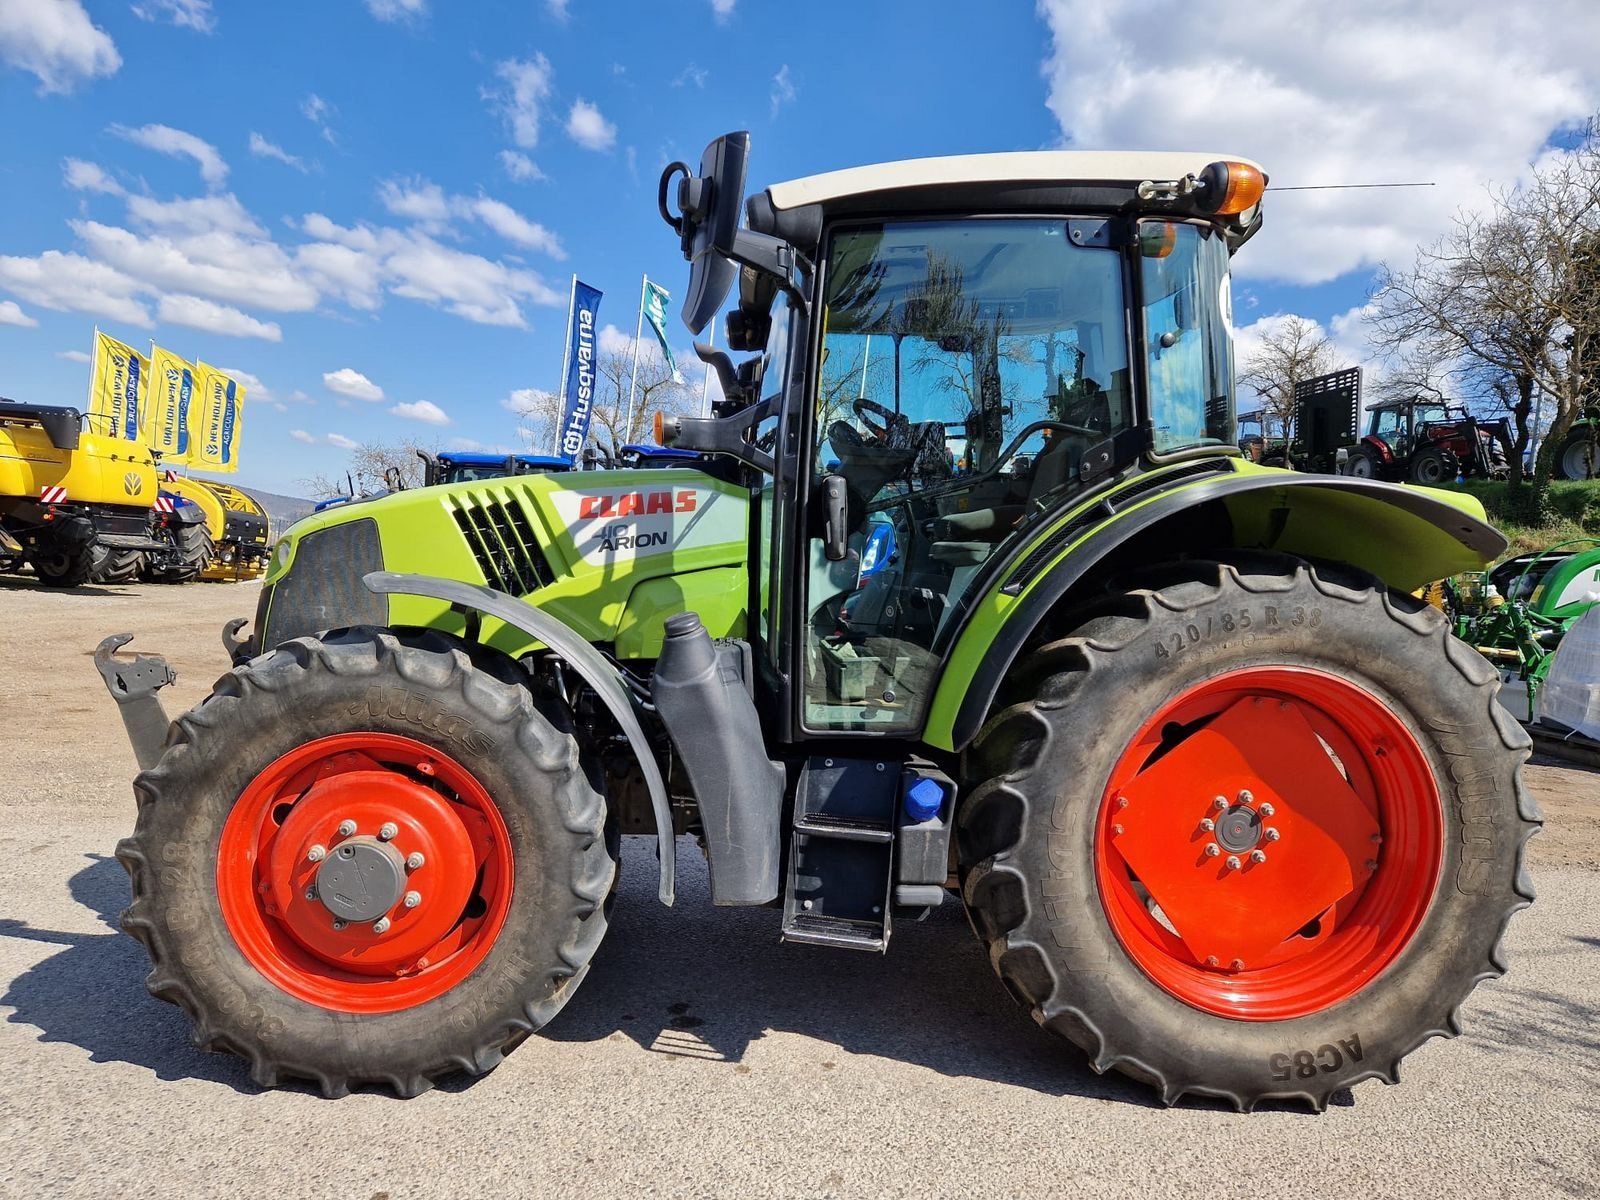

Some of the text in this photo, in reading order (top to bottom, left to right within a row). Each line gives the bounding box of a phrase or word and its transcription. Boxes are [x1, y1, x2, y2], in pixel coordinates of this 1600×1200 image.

[570, 309, 594, 430] Husqvarna
[210, 382, 222, 442] NEW HOLLAND
[579, 491, 697, 520] CLAAS
[598, 532, 668, 553] ARION
[1153, 608, 1252, 660] 420/85
[1264, 606, 1281, 627] R
[1291, 606, 1323, 628] 38
[1269, 1032, 1364, 1082] AC85
